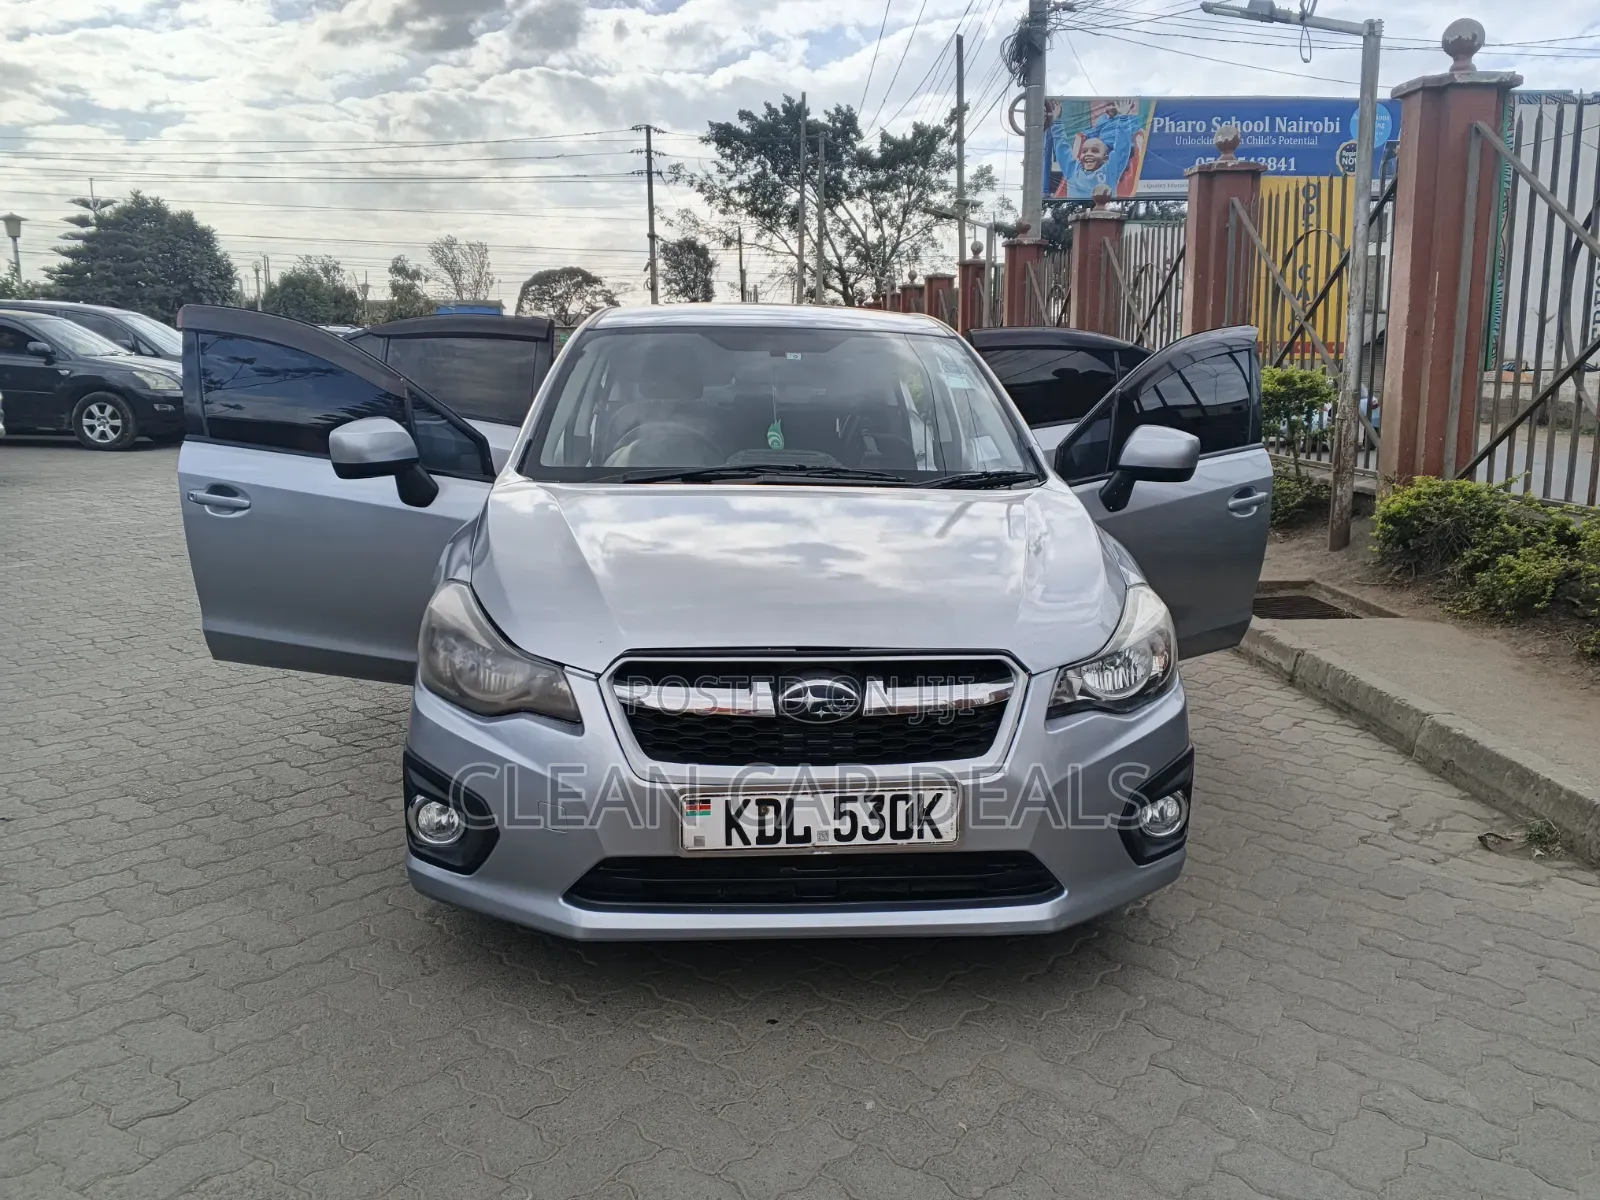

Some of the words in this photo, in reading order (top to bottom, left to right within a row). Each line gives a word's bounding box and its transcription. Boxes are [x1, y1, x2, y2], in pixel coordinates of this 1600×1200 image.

[1153, 116, 1207, 133] Pharo
[1275, 116, 1341, 133] Nairobi
[1175, 135, 1215, 146] Unlockin
[1246, 135, 1277, 145] Child's
[1278, 135, 1318, 146] Potential
[724, 797, 813, 847] KDL
[833, 792, 944, 843] 530K
